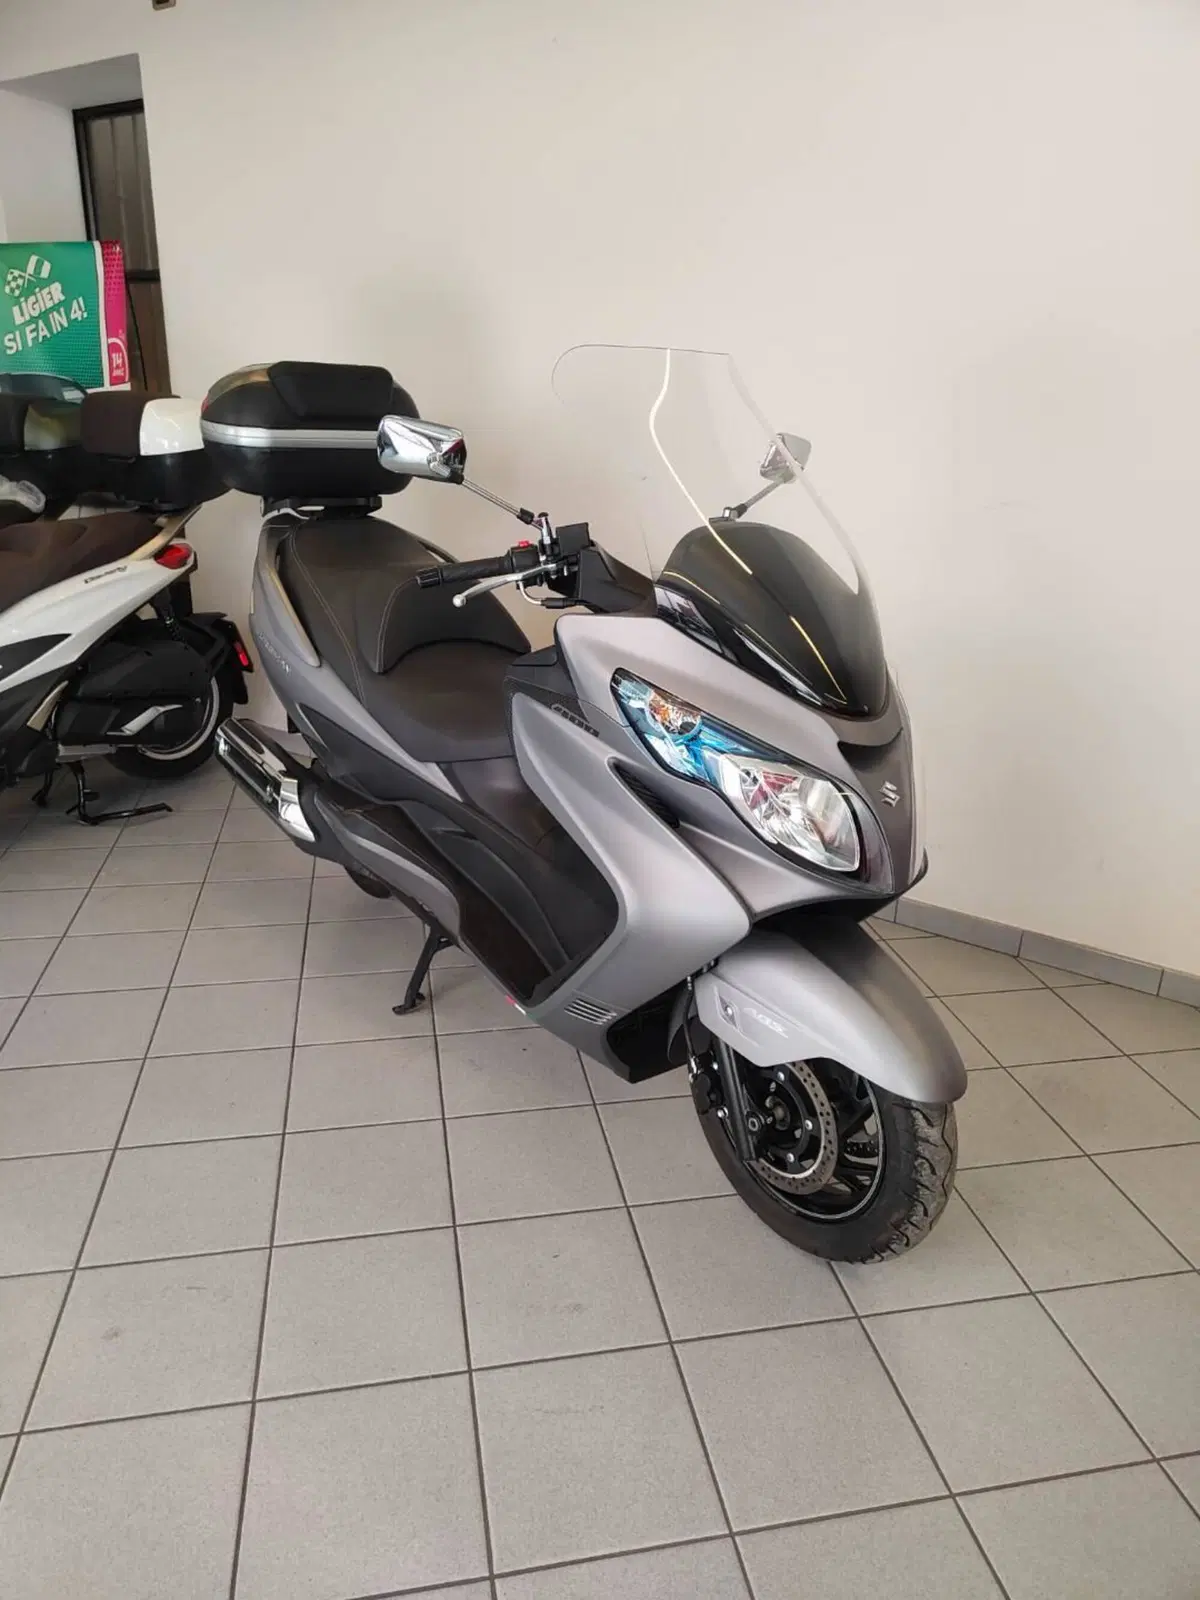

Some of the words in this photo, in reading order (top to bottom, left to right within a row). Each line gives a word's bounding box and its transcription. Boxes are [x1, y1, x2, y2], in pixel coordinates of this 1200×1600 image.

[4, 330, 22, 355] SI
[25, 319, 51, 347] FA
[49, 306, 68, 334] IN
[70, 296, 88, 321] 4!
